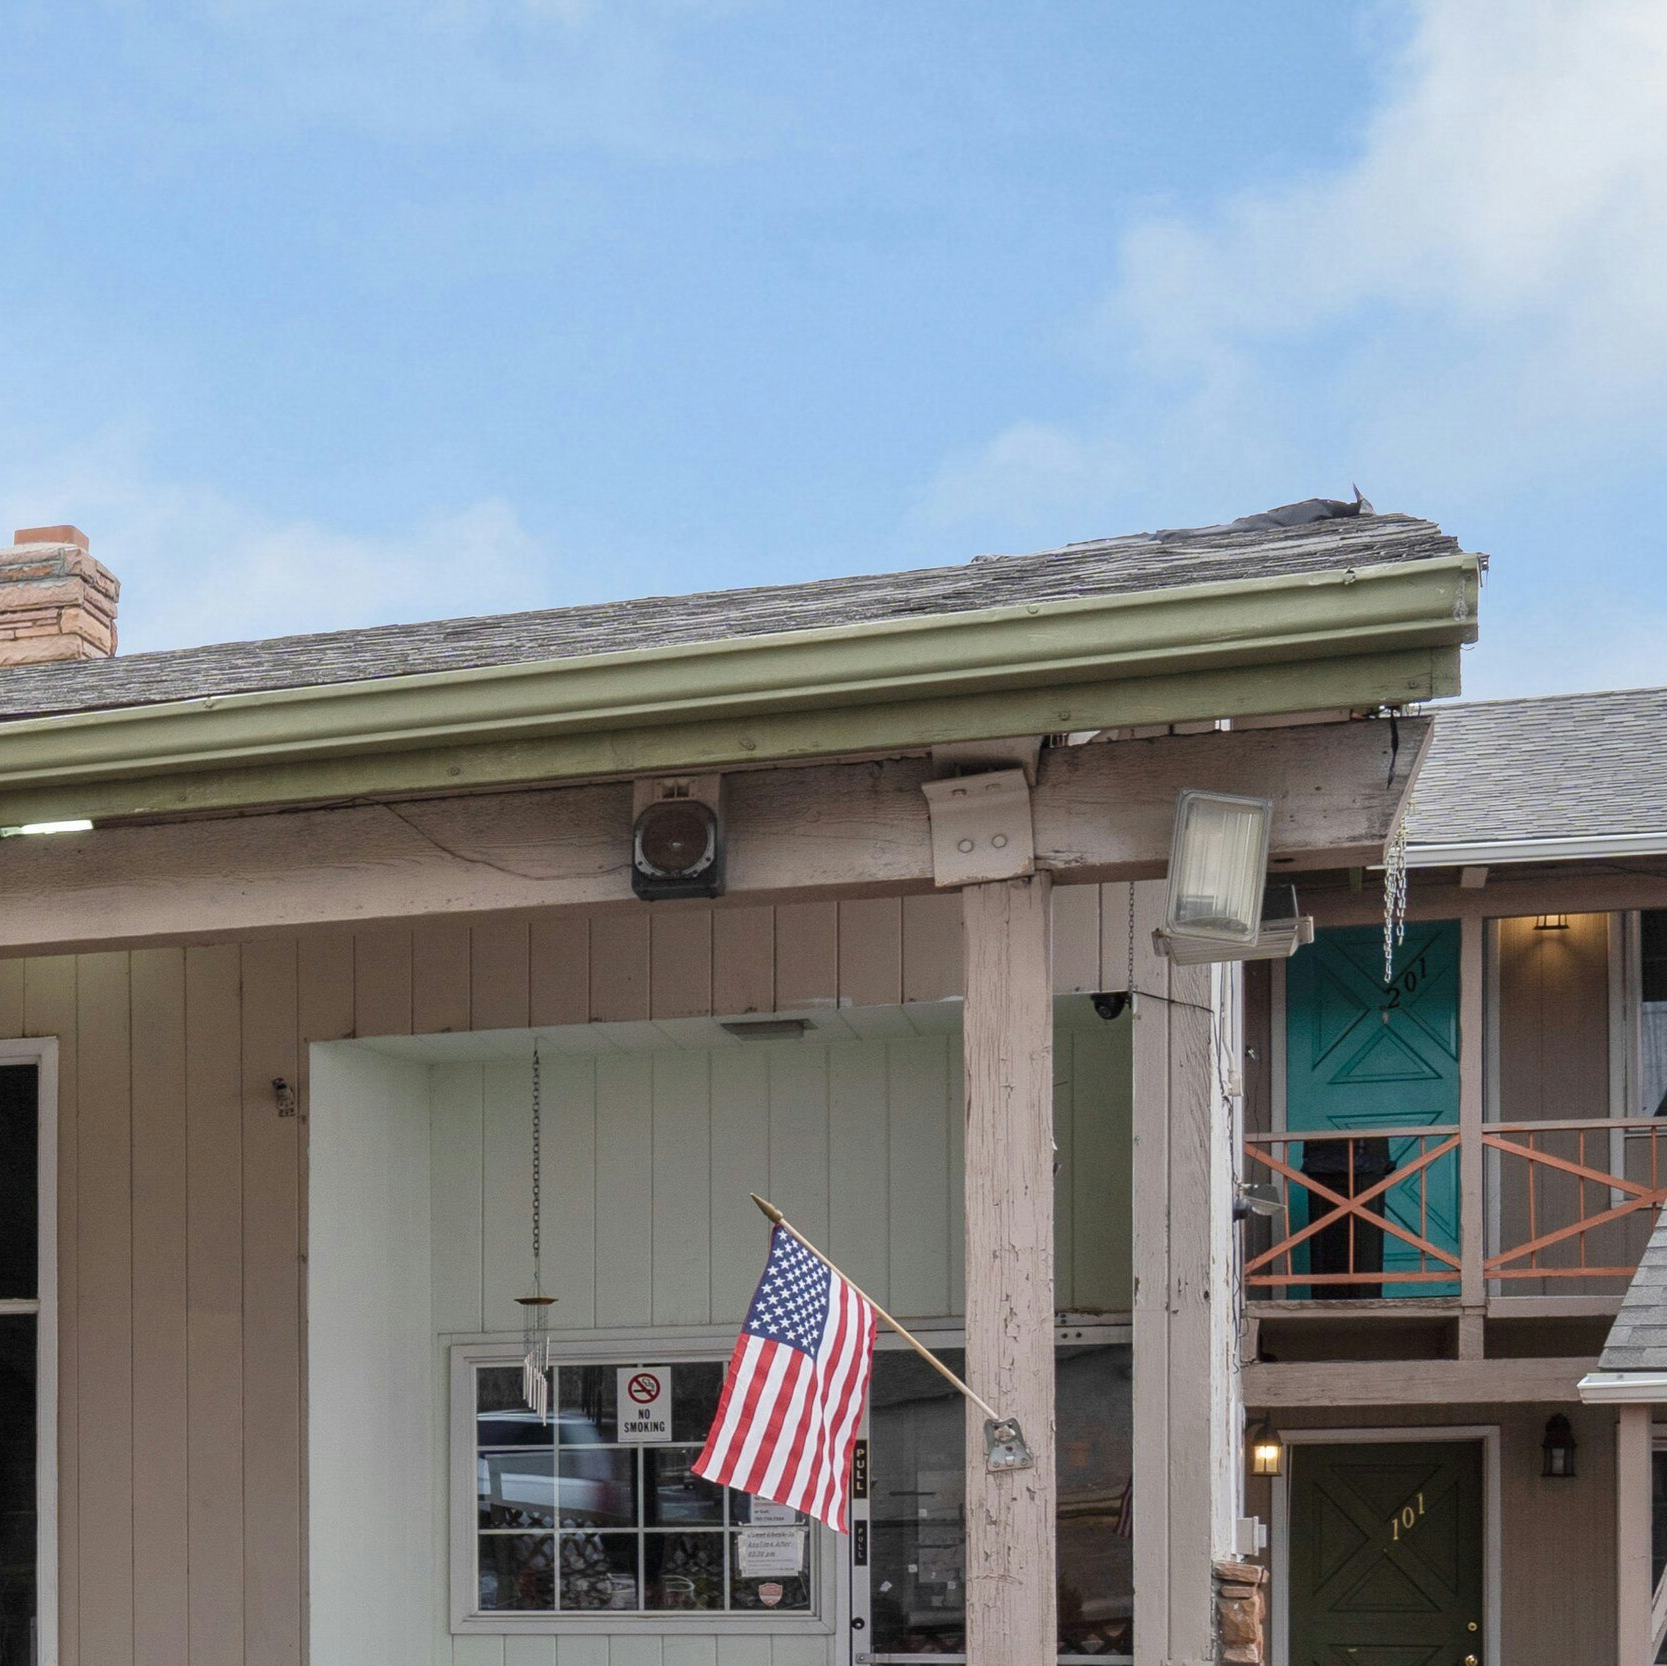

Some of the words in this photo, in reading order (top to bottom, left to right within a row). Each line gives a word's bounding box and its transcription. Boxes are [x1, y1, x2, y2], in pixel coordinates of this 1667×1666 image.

[1384, 957, 1426, 1009] 201
[624, 1421, 665, 1433] SMOKING
[638, 1408, 650, 1419] NO
[856, 1448, 865, 1490] PULL
[1391, 1492, 1425, 1541] 101
